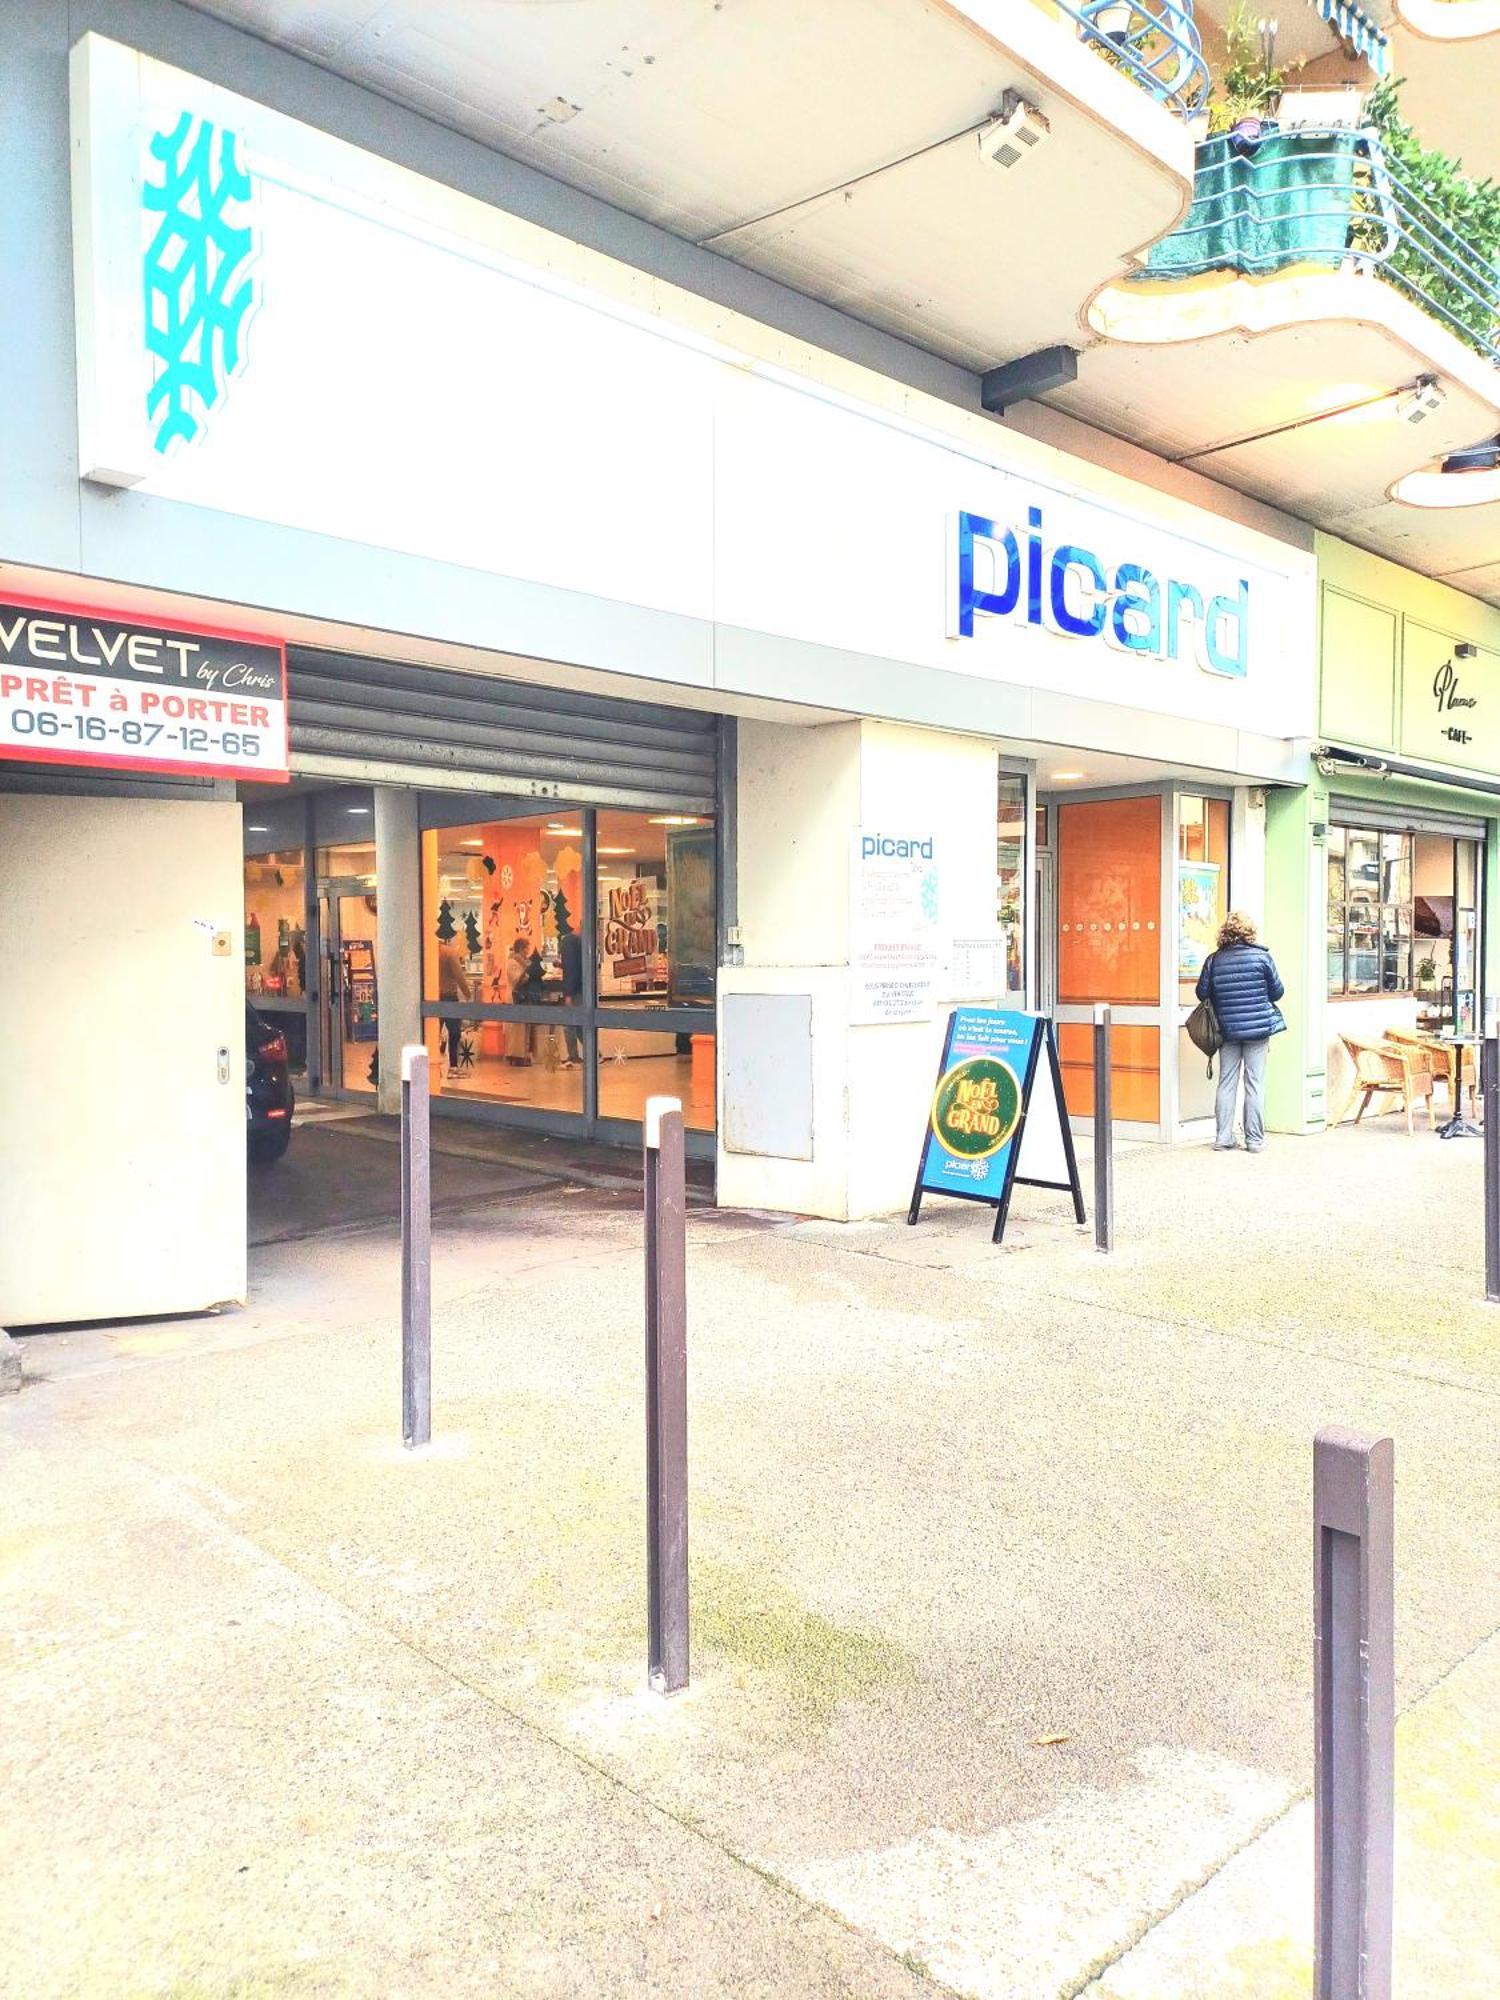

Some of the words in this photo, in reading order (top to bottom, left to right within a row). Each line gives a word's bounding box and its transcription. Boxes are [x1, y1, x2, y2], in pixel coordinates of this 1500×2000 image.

[958, 505, 1249, 678] picard
[0, 616, 200, 678] VELVET
[196, 661, 219, 691] by
[222, 663, 276, 689] Chris
[1, 674, 97, 708] PRÊT
[109, 688, 129, 712] à
[141, 691, 270, 728] PORTER
[11, 708, 261, 757] 06-16-87-12-65
[861, 832, 933, 860] picard
[946, 1108, 1000, 1136] GRAND
